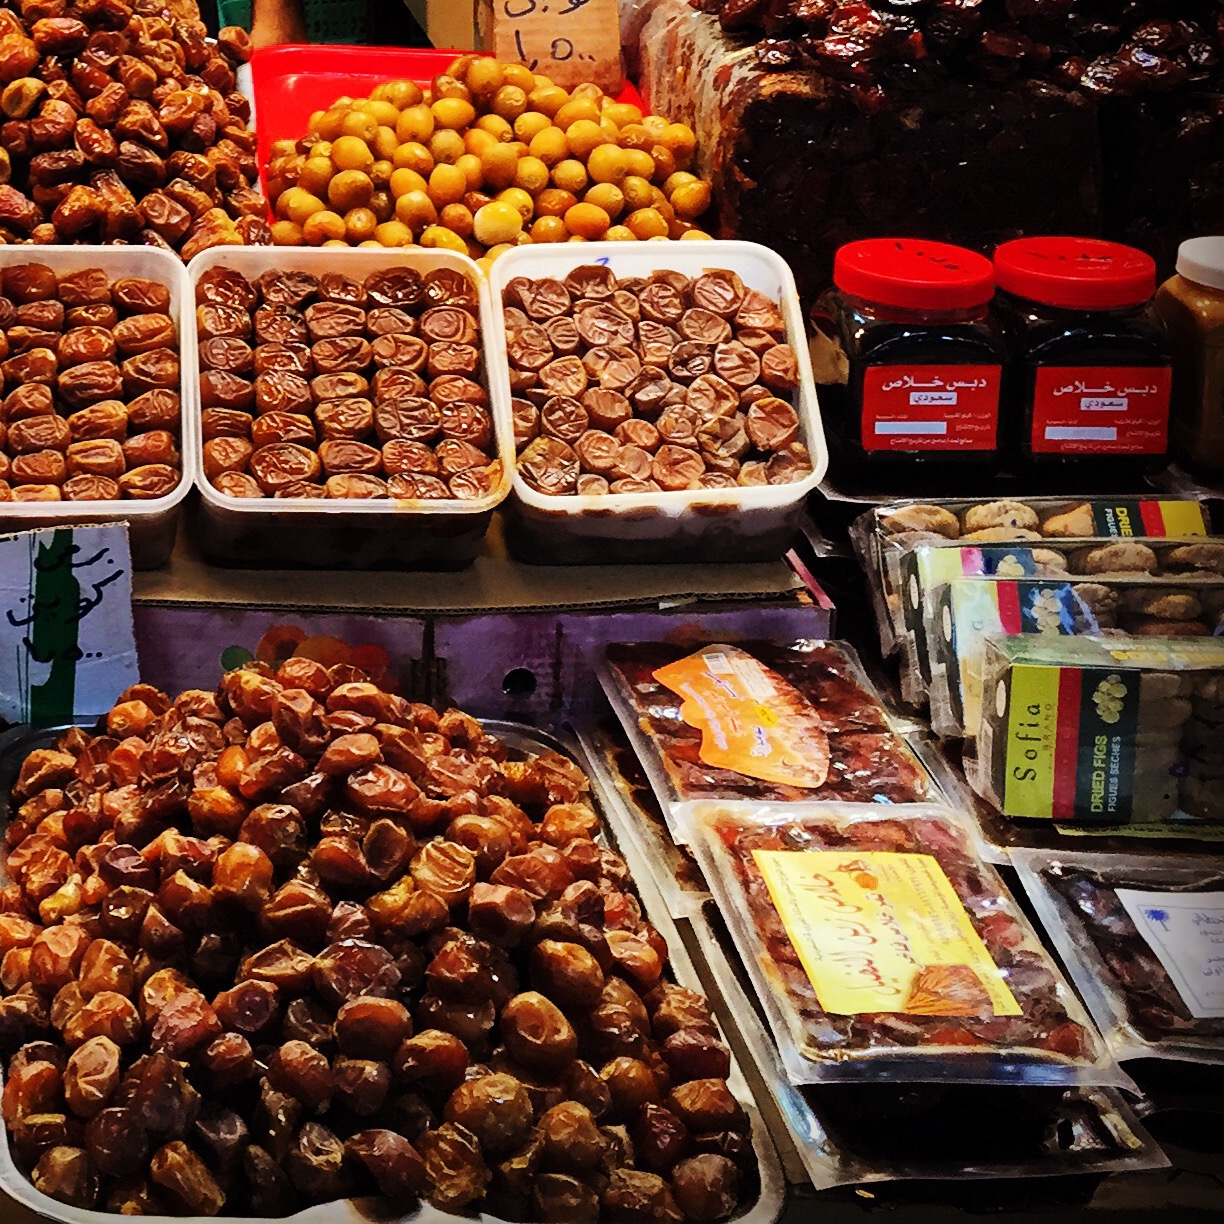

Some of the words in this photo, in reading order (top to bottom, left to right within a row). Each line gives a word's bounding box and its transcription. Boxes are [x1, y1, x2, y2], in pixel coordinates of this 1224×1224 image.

[881, 375, 944, 391] خلاص
[945, 378, 987, 391] دبس
[1053, 381, 1115, 396] خلاص
[1116, 384, 1158, 397] دبس
[913, 394, 953, 404] سعودي
[1084, 400, 1124, 409] سعودي
[1104, 508, 1118, 537] FIGUE
[1116, 507, 1134, 537] DRIE
[1013, 703, 1042, 782] Sofia
[1093, 735, 1108, 768] FIGS
[1091, 771, 1106, 813] DRIED
[1108, 778, 1119, 812] FIGUES
[792, 872, 862, 914] خلاص
[824, 917, 877, 945] زين
[829, 951, 901, 995] النخيل
